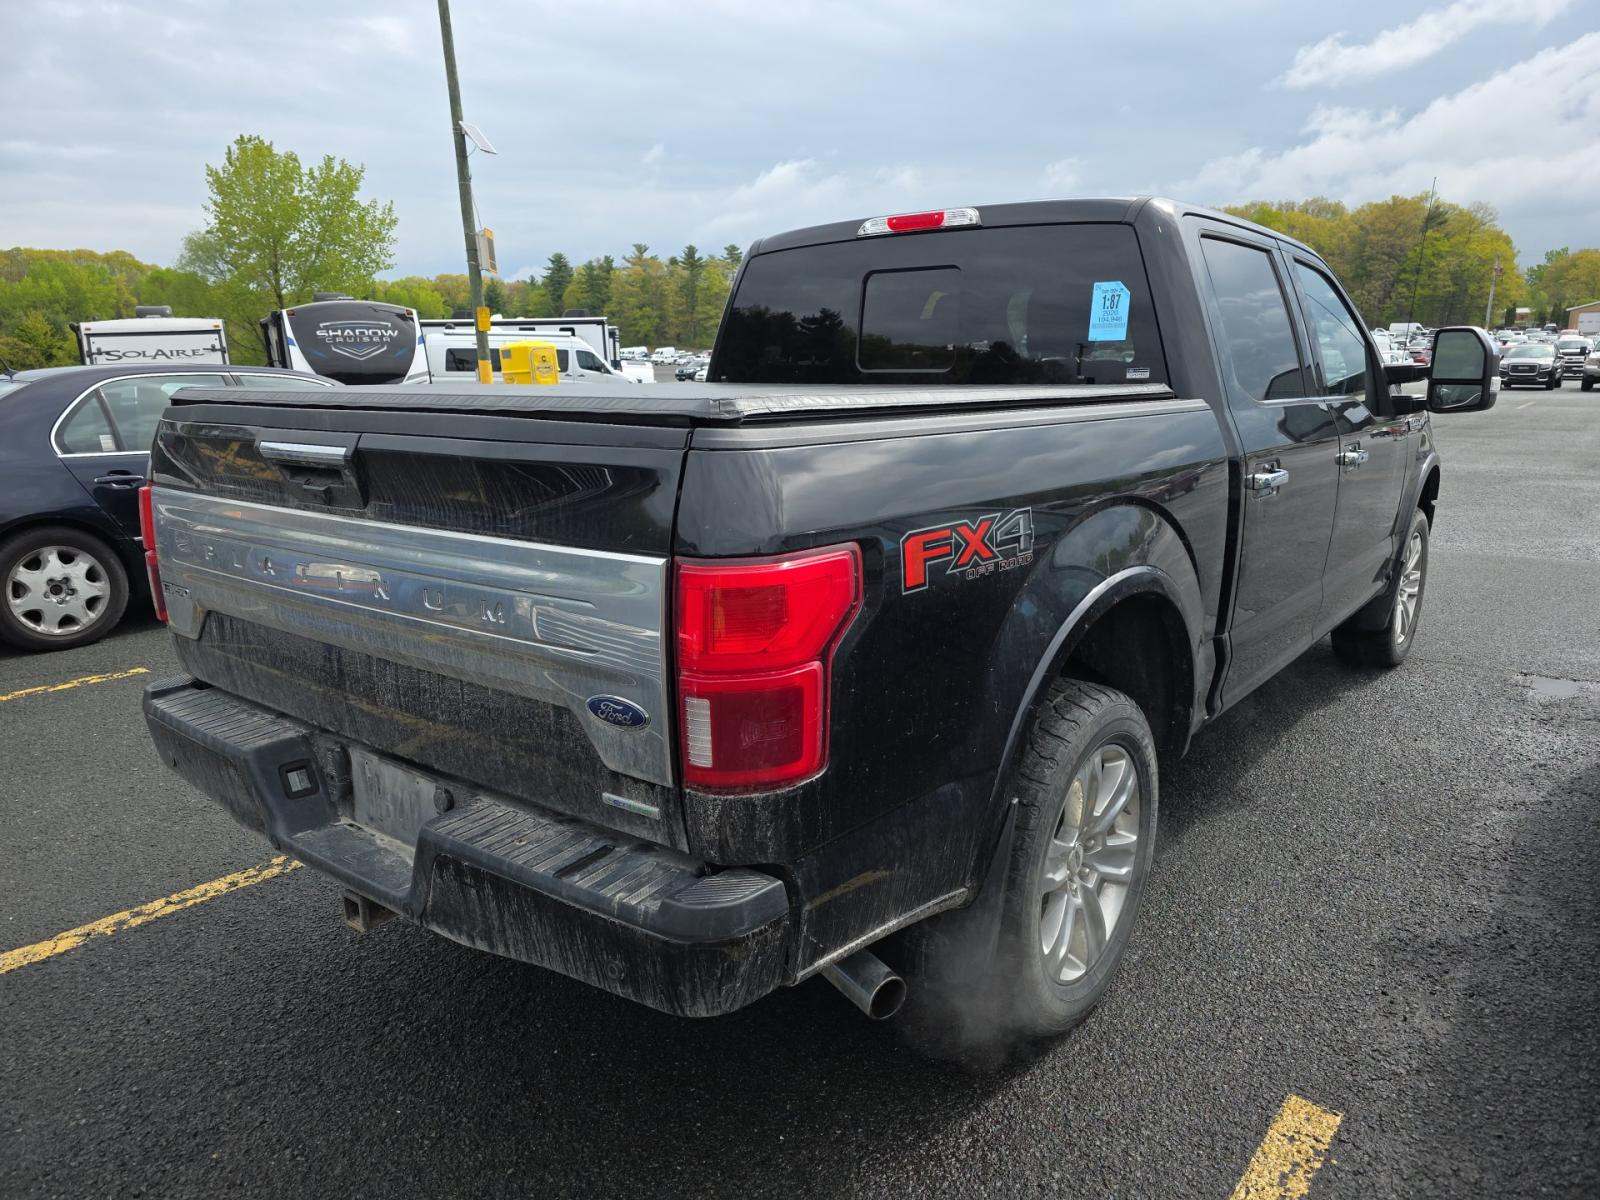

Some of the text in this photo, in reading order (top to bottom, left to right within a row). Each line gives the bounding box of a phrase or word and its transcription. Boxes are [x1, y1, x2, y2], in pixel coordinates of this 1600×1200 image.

[316, 328, 398, 338] SHADOW
[105, 348, 205, 361] SOLAIRE
[900, 507, 1035, 595] FX4
[966, 553, 1034, 580] OFF ROAD
[598, 701, 633, 725] Ford
